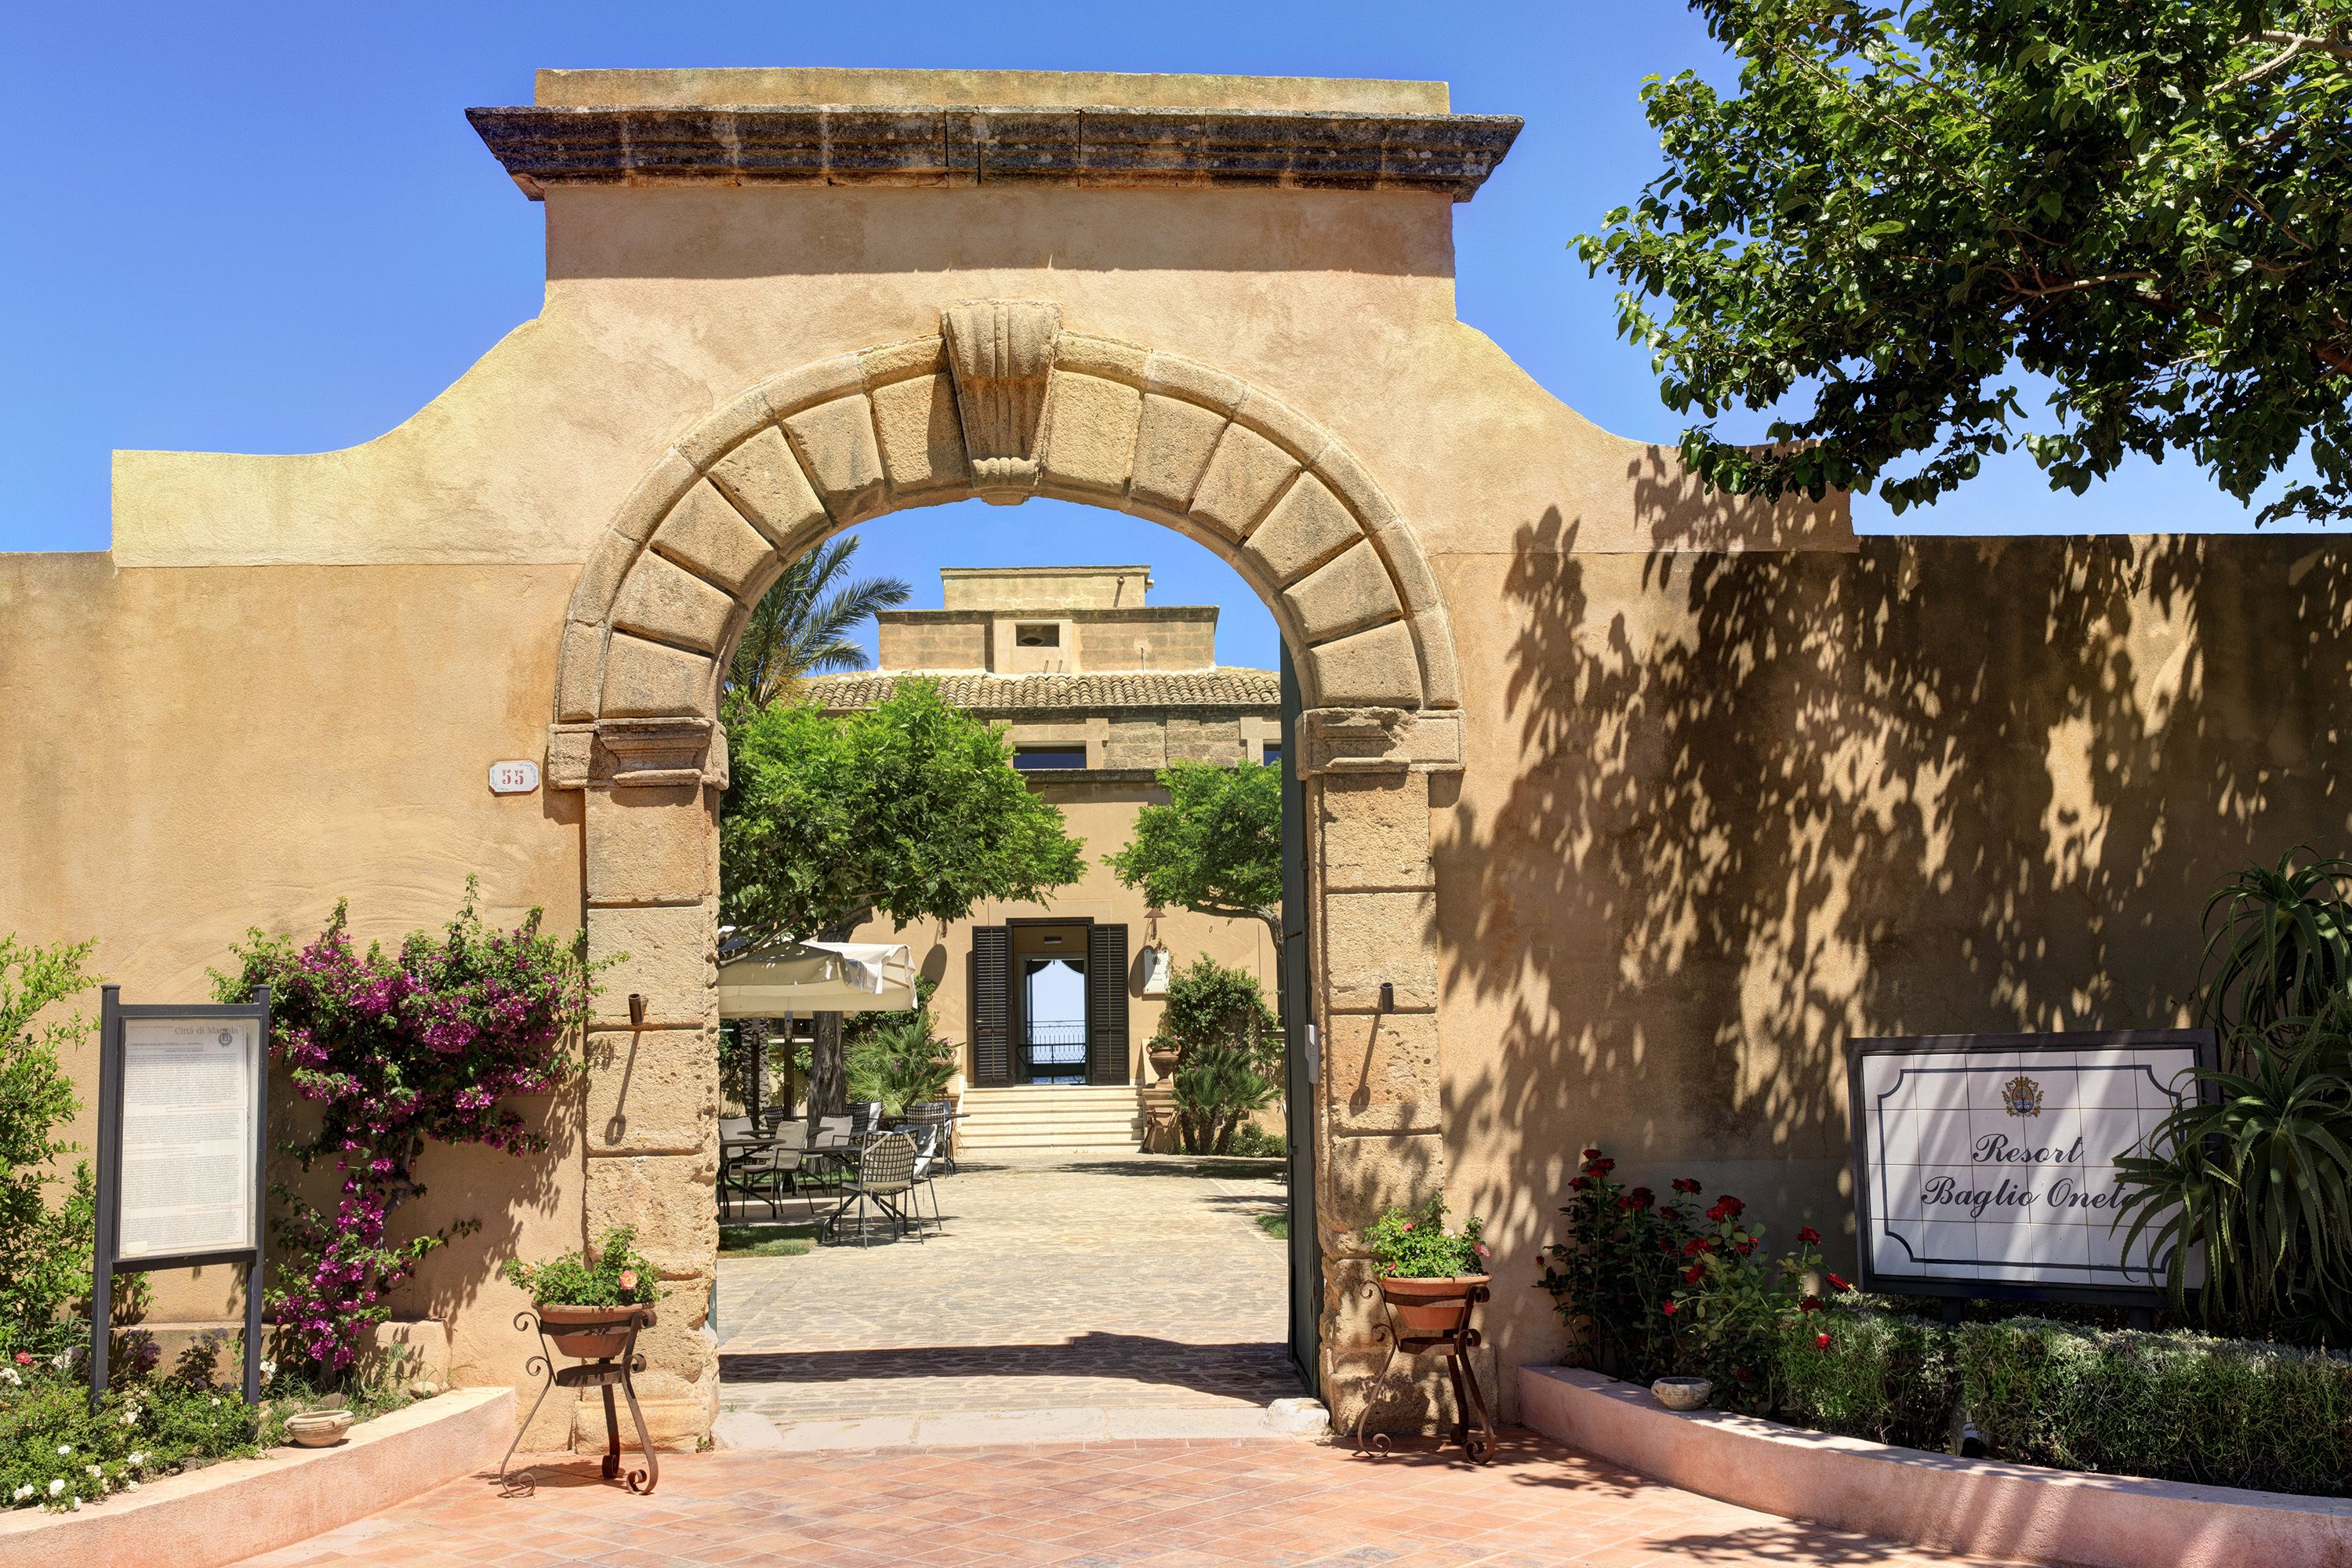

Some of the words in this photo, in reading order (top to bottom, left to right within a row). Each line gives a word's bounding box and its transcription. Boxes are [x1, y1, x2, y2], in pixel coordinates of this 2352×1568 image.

[502, 769, 524, 785] 55
[175, 1026, 194, 1035] Città
[197, 1026, 205, 1035] di
[207, 1026, 238, 1035] Marla
[1973, 1134, 2085, 1163] Resort
[1922, 1176, 2042, 1218] Baglio
